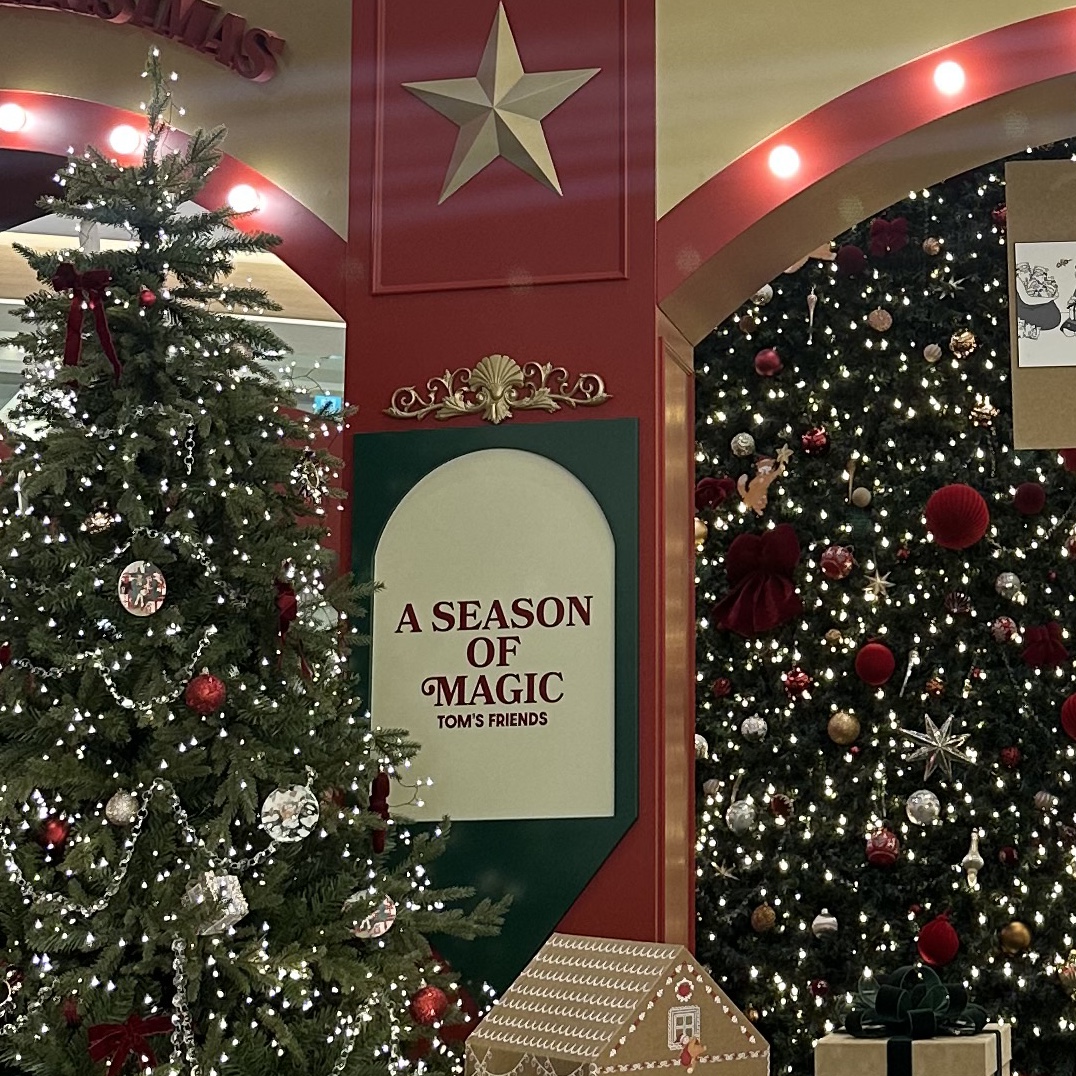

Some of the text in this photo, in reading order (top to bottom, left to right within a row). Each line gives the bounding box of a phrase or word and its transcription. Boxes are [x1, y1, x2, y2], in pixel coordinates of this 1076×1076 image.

[394, 595, 594, 634] A SEASON
[466, 635, 521, 668] OF
[421, 671, 564, 707] MAGIC
[437, 711, 549, 729] TOM'S FRIENDS
